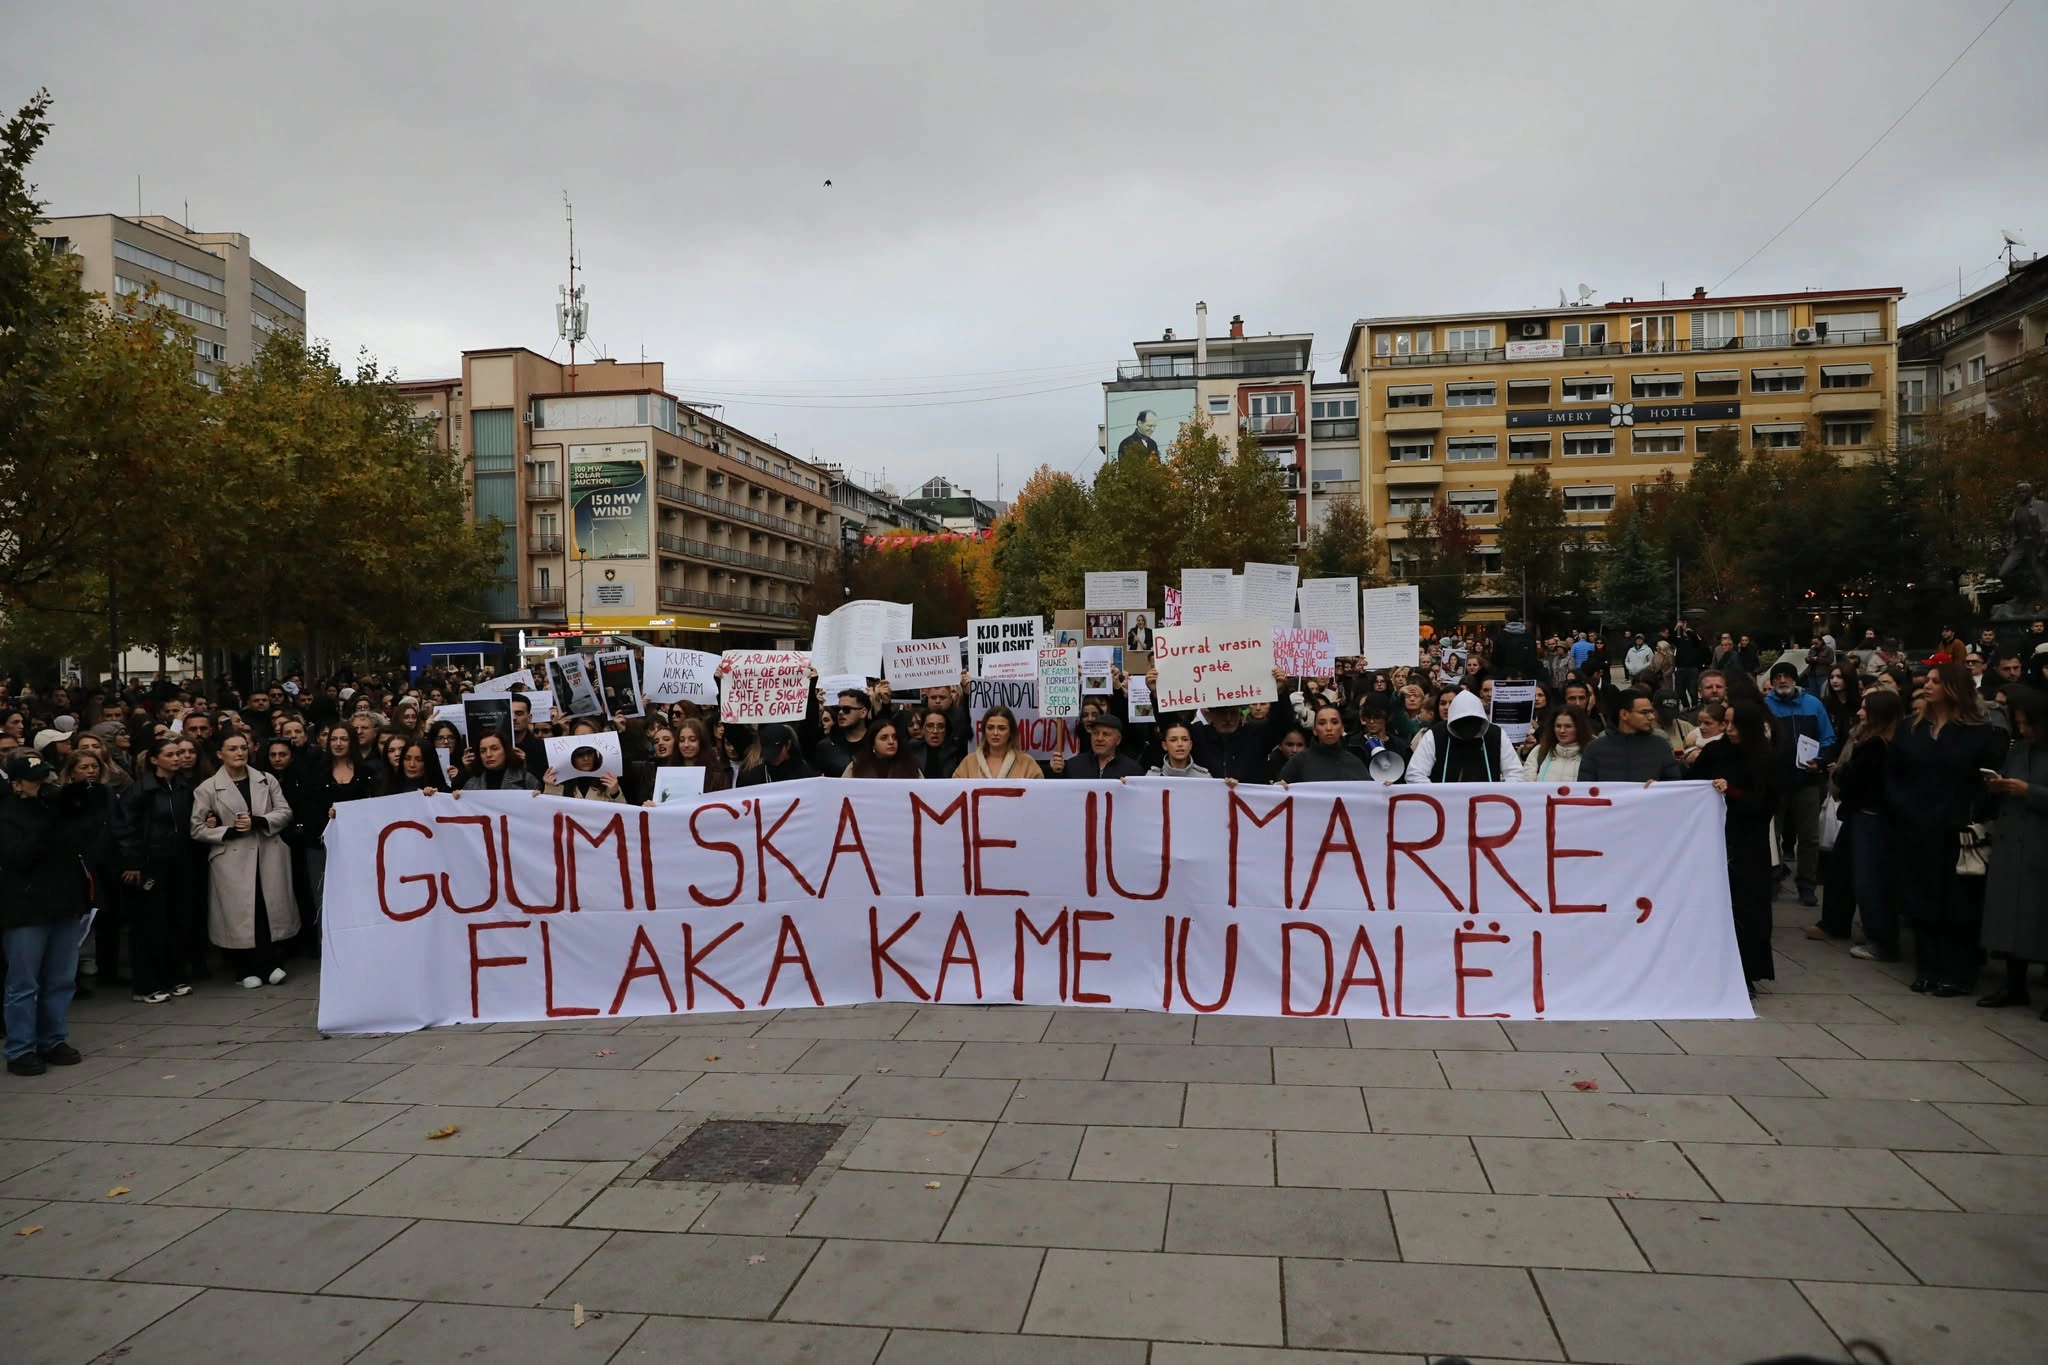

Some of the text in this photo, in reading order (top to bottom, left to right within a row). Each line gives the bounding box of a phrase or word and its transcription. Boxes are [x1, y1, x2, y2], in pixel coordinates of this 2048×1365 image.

[1547, 407, 1697, 423] EMERY HOTEL
[574, 478, 611, 486] AUCTION
[591, 493, 642, 506] 150 MW
[592, 505, 632, 517] WIND
[977, 620, 1034, 640] KJO PUNË
[1289, 628, 1329, 643] ARLINDA
[896, 641, 947, 654] KRONIKA
[977, 641, 1000, 655] NUK
[1039, 649, 1066, 658] STOP
[1154, 636, 1261, 659] Burrat vrasin
[665, 652, 704, 668] KURRE
[744, 653, 791, 665] ARLINDA
[915, 654, 951, 666] VRASJEJE
[658, 681, 704, 695] ARSYETIM
[757, 678, 780, 690] ENDE
[782, 678, 803, 688] NUK
[764, 690, 770, 700] E
[968, 680, 1038, 709] PARANDAL
[1160, 687, 1206, 708] shteti
[1045, 705, 1071, 716] STOP
[553, 739, 570, 755] AM
[377, 810, 657, 922] GJUMI
[689, 796, 881, 907] S'KA
[909, 788, 1030, 896] ME
[1085, 789, 1170, 899] IU
[468, 915, 825, 1018] FLAKA
[1163, 915, 1238, 1013] IU
